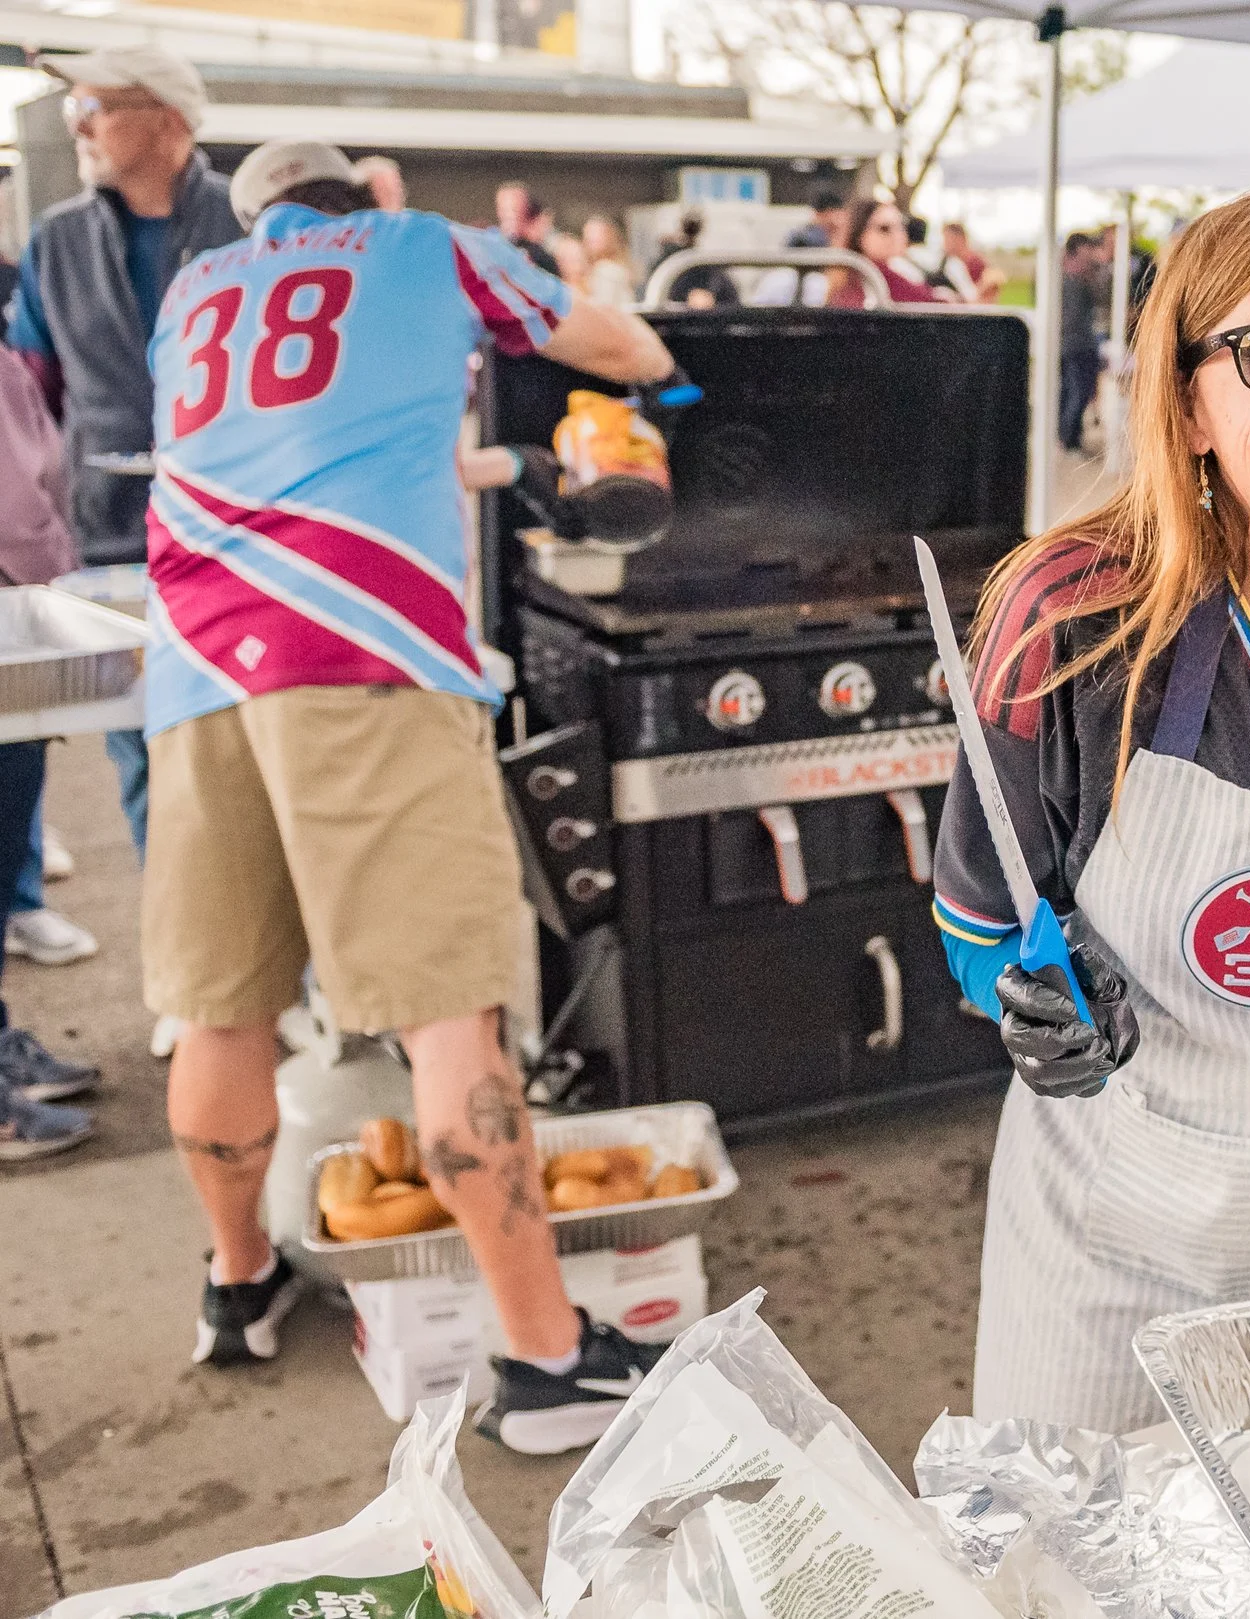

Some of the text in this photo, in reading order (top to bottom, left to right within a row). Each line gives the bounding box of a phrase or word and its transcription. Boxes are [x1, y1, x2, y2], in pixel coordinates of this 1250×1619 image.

[173, 266, 354, 440] 38
[694, 1433, 739, 1480] INSTRUCTIONS
[738, 1453, 763, 1473] AMOUNT
[746, 1460, 771, 1480] FROZEN
[766, 1493, 785, 1513] WATER
[784, 1493, 806, 1519] SECOND
